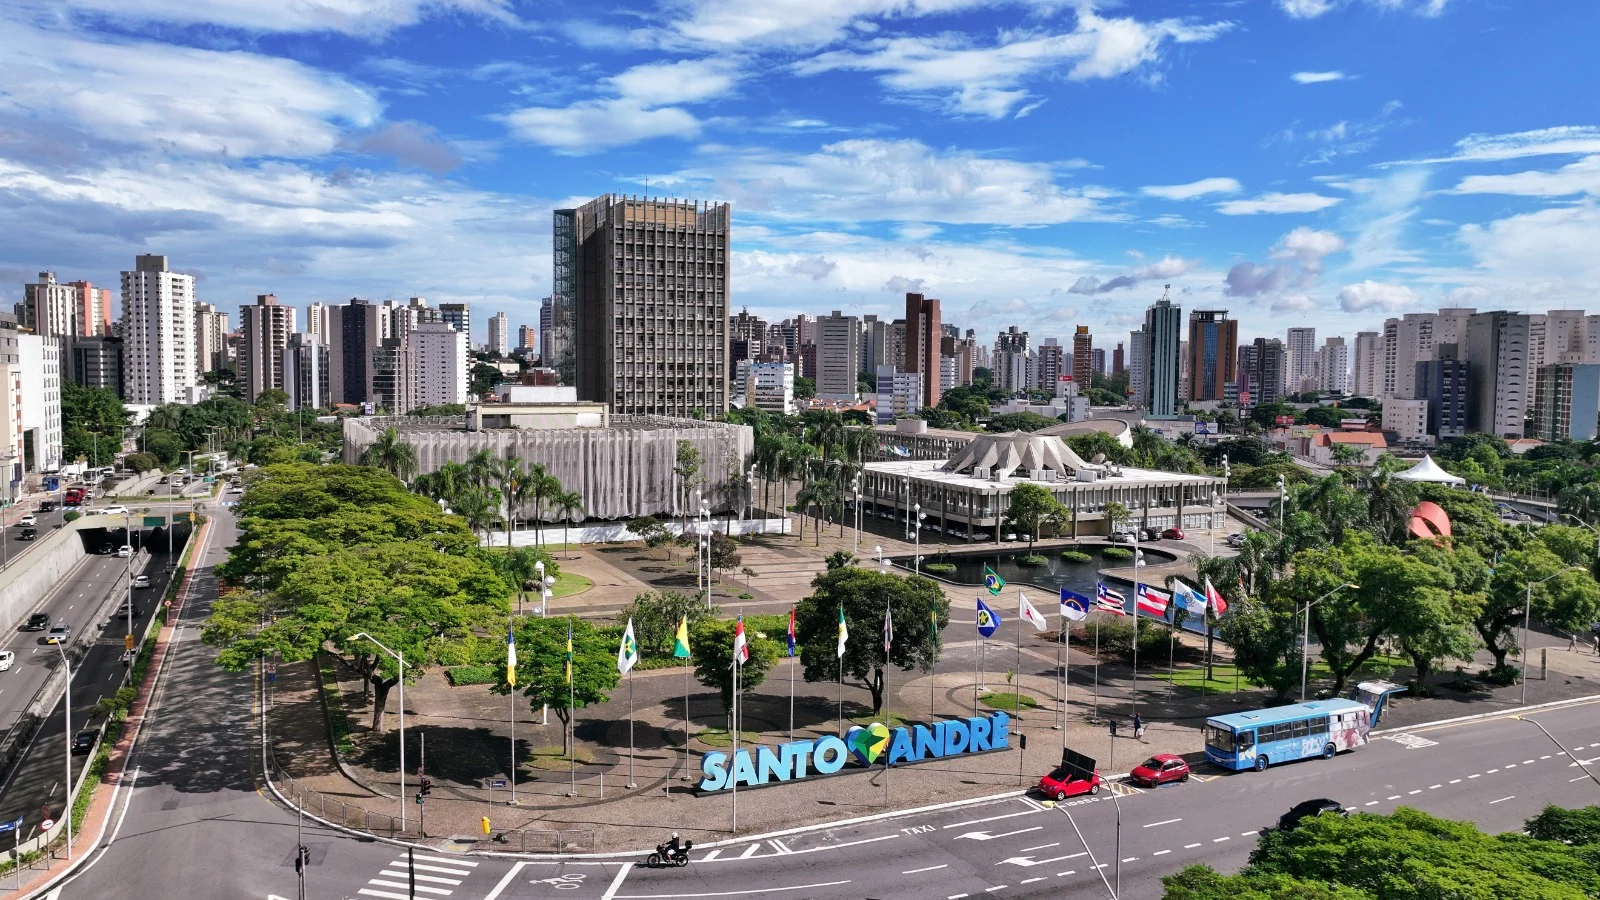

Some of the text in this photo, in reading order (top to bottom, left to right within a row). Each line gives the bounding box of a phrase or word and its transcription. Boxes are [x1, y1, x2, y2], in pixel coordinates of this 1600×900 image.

[700, 711, 1009, 791] SANTO ANDRÉ
[901, 825, 936, 835] TAXI
